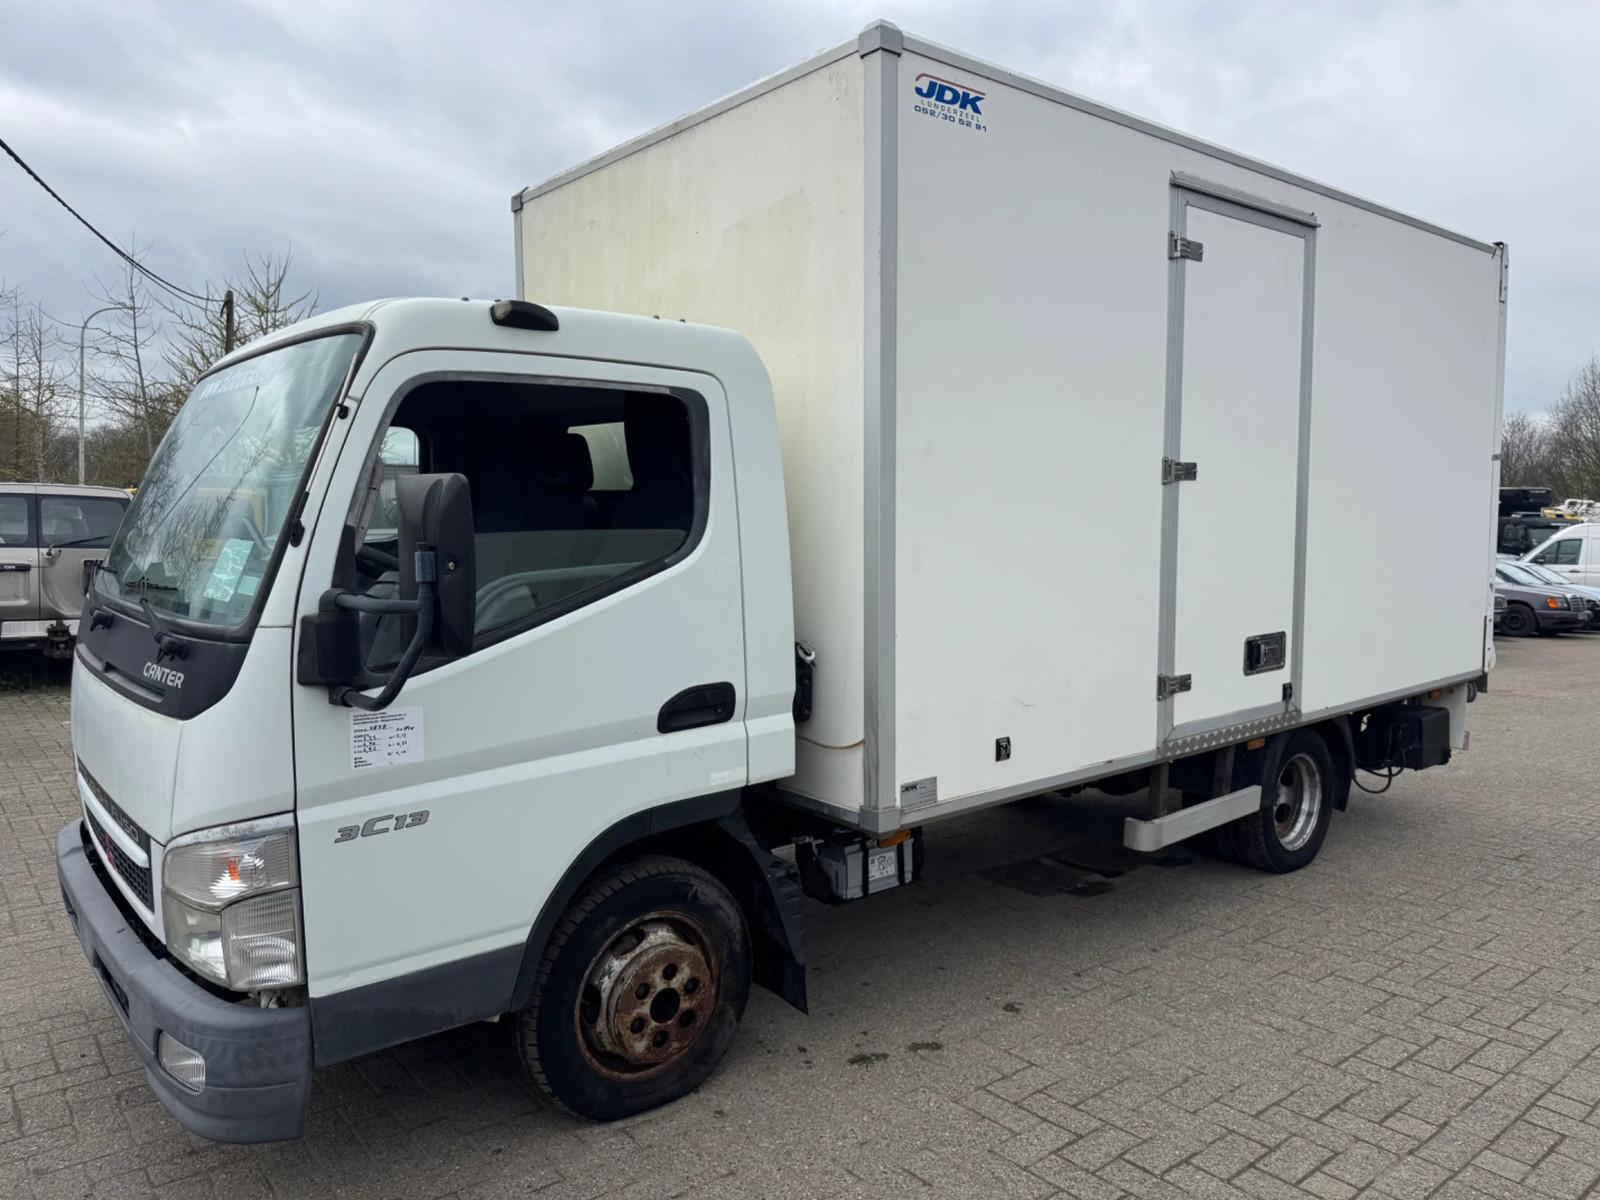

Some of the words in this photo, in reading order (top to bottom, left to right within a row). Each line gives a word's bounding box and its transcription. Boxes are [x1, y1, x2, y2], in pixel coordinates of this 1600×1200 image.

[915, 80, 985, 115] JDK
[921, 99, 982, 122] LONDERZEEL
[143, 661, 185, 689] CANTER
[334, 810, 430, 844] 3C13
